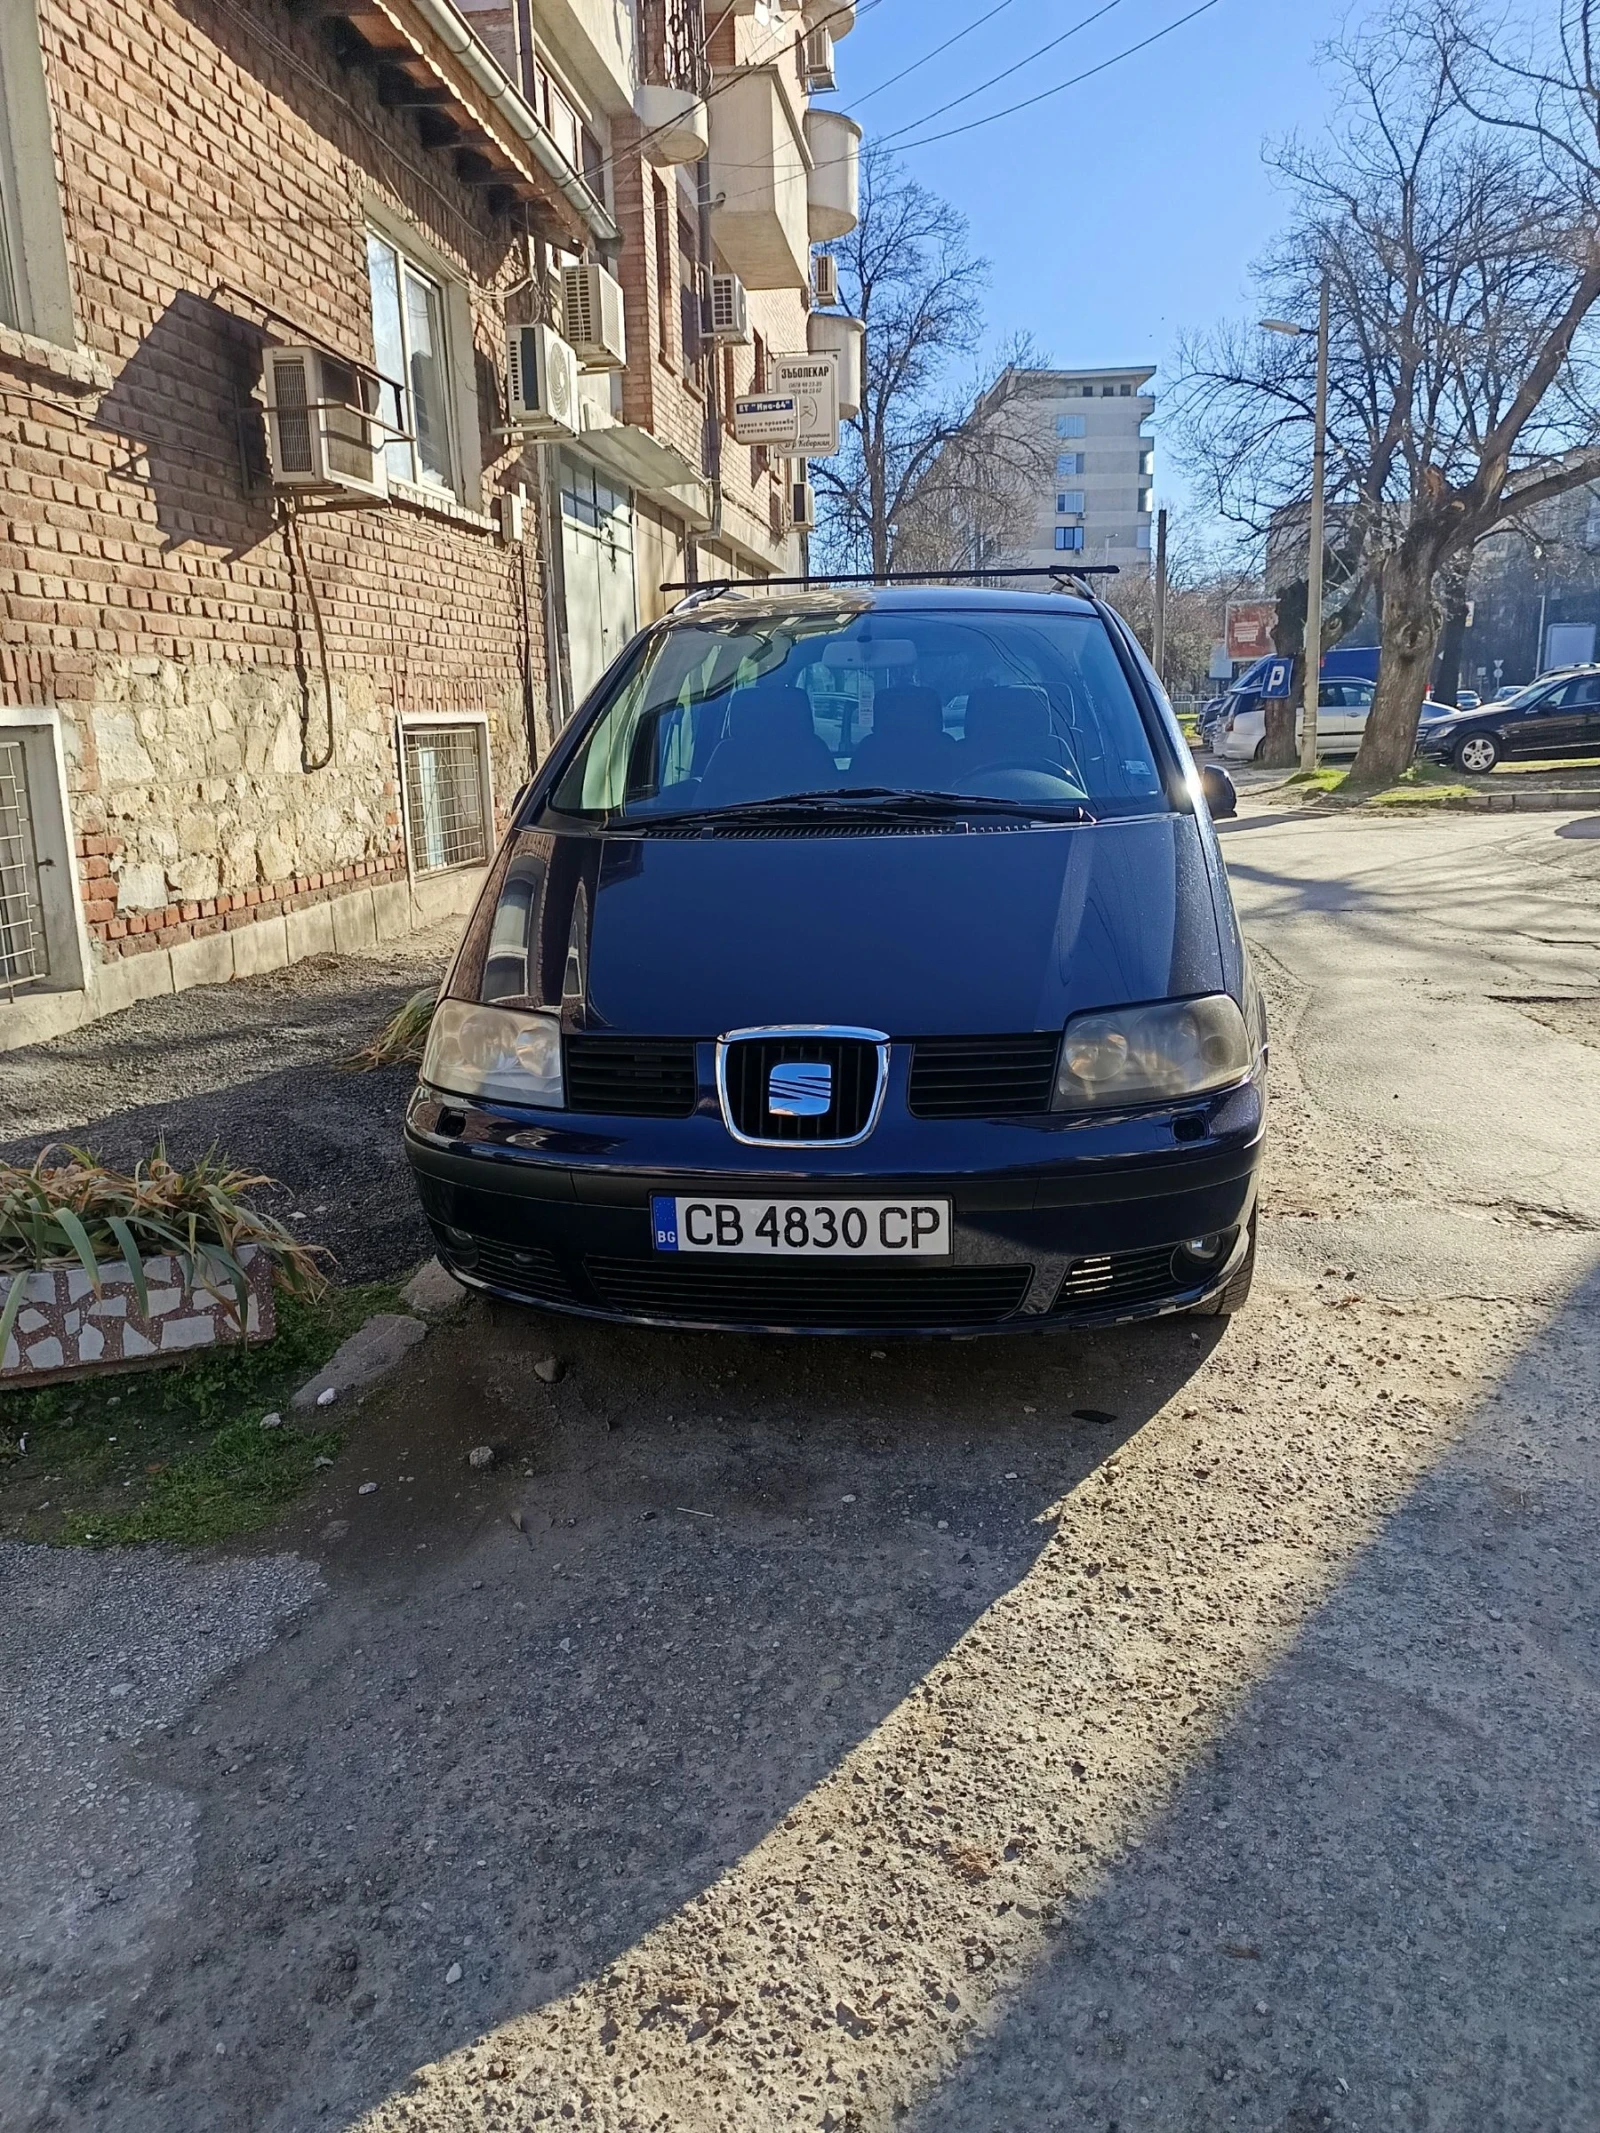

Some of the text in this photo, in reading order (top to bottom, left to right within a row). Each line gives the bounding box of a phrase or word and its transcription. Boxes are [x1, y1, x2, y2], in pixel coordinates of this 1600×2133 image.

[781, 366, 829, 379] ЗЪБОЛЕКАР
[1267, 665, 1285, 692] P
[657, 1204, 941, 1249] BG CB 4830 CP
